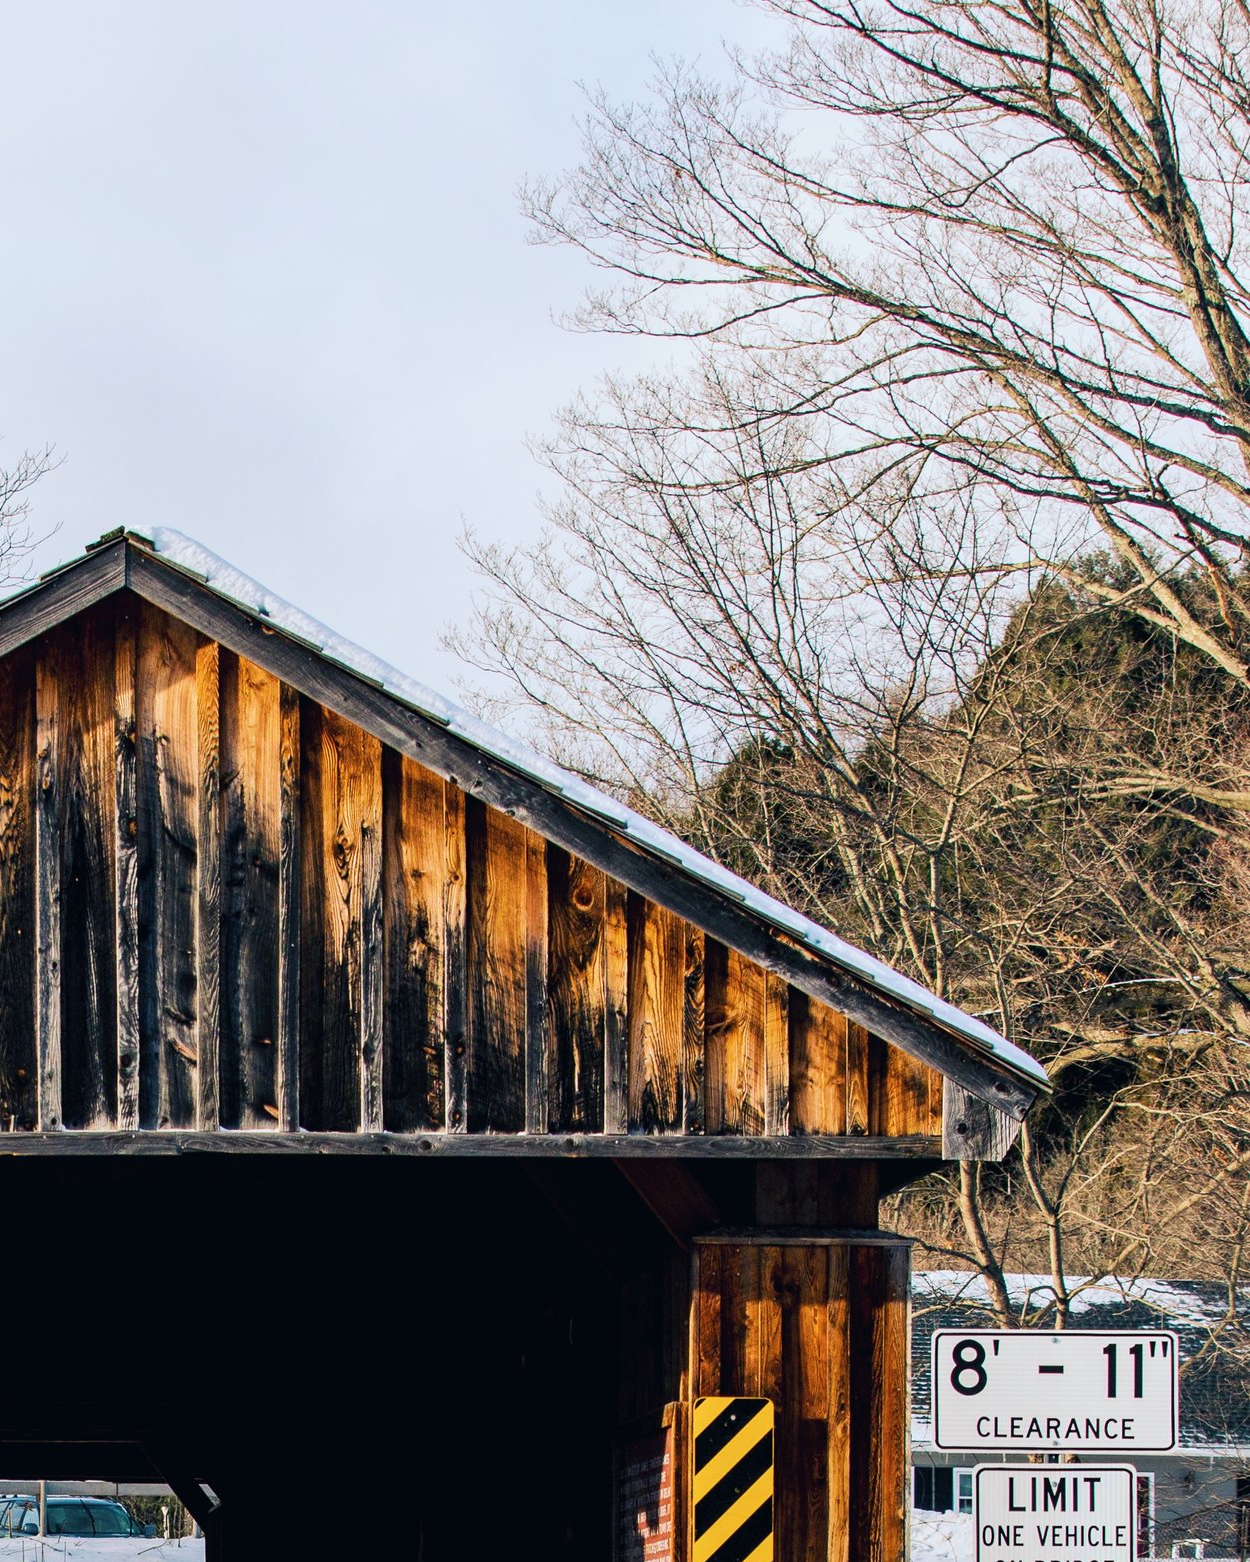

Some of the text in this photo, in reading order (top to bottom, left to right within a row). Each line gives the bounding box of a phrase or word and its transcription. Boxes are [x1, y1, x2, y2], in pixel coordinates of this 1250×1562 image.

[950, 1339, 1000, 1396] 8'
[976, 1416, 1135, 1440] CLEARANCE
[1008, 1477, 1101, 1512] LIMIT
[982, 1525, 1127, 1547] ONE VEHICLE
